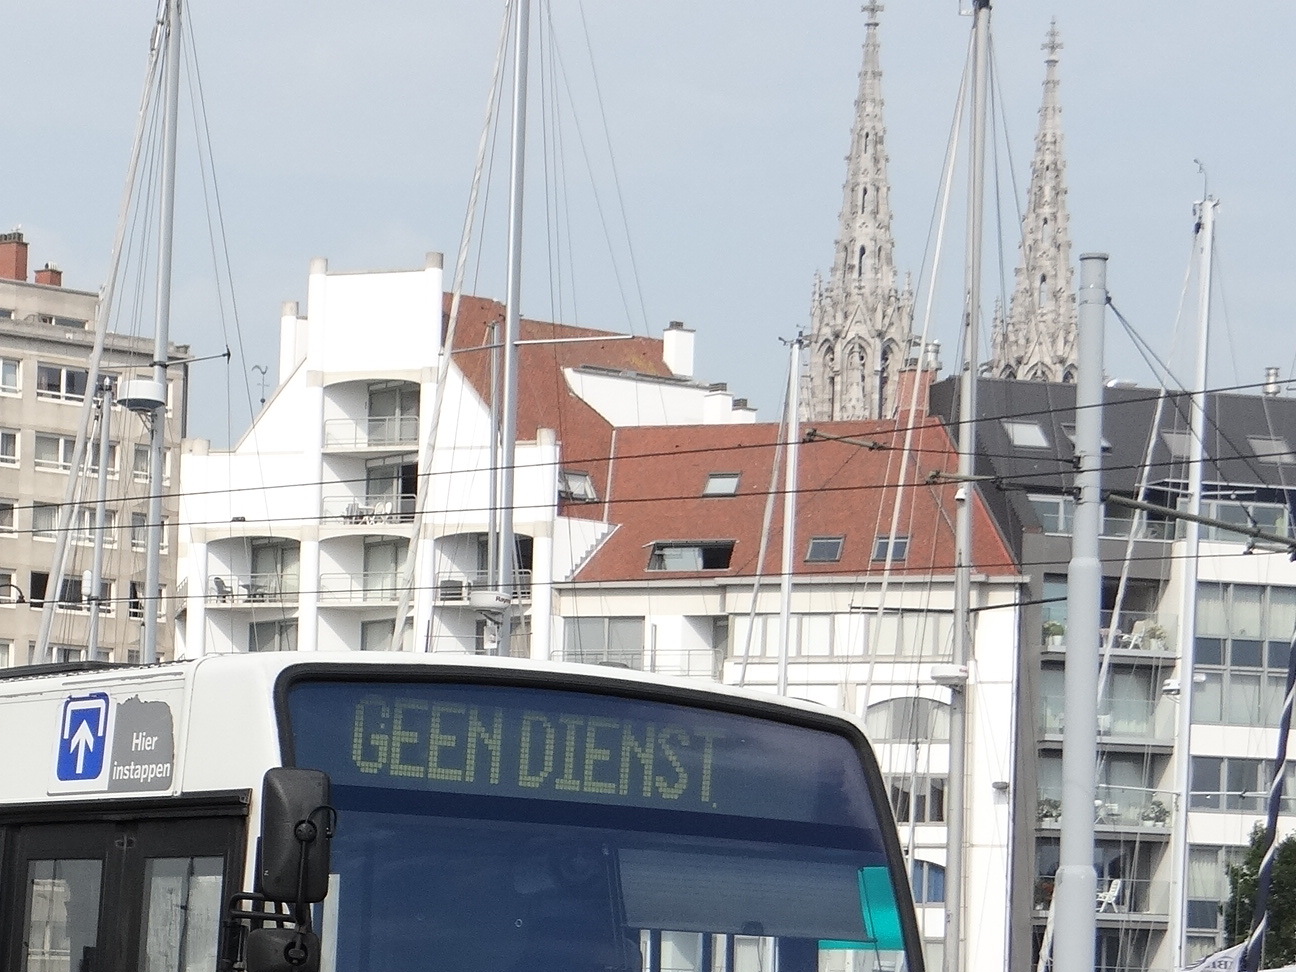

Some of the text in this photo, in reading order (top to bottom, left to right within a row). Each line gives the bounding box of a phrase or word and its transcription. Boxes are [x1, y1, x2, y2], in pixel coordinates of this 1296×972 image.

[131, 731, 158, 751] Hier
[352, 694, 725, 802] GEEN DIENST
[112, 761, 171, 783] instappen
